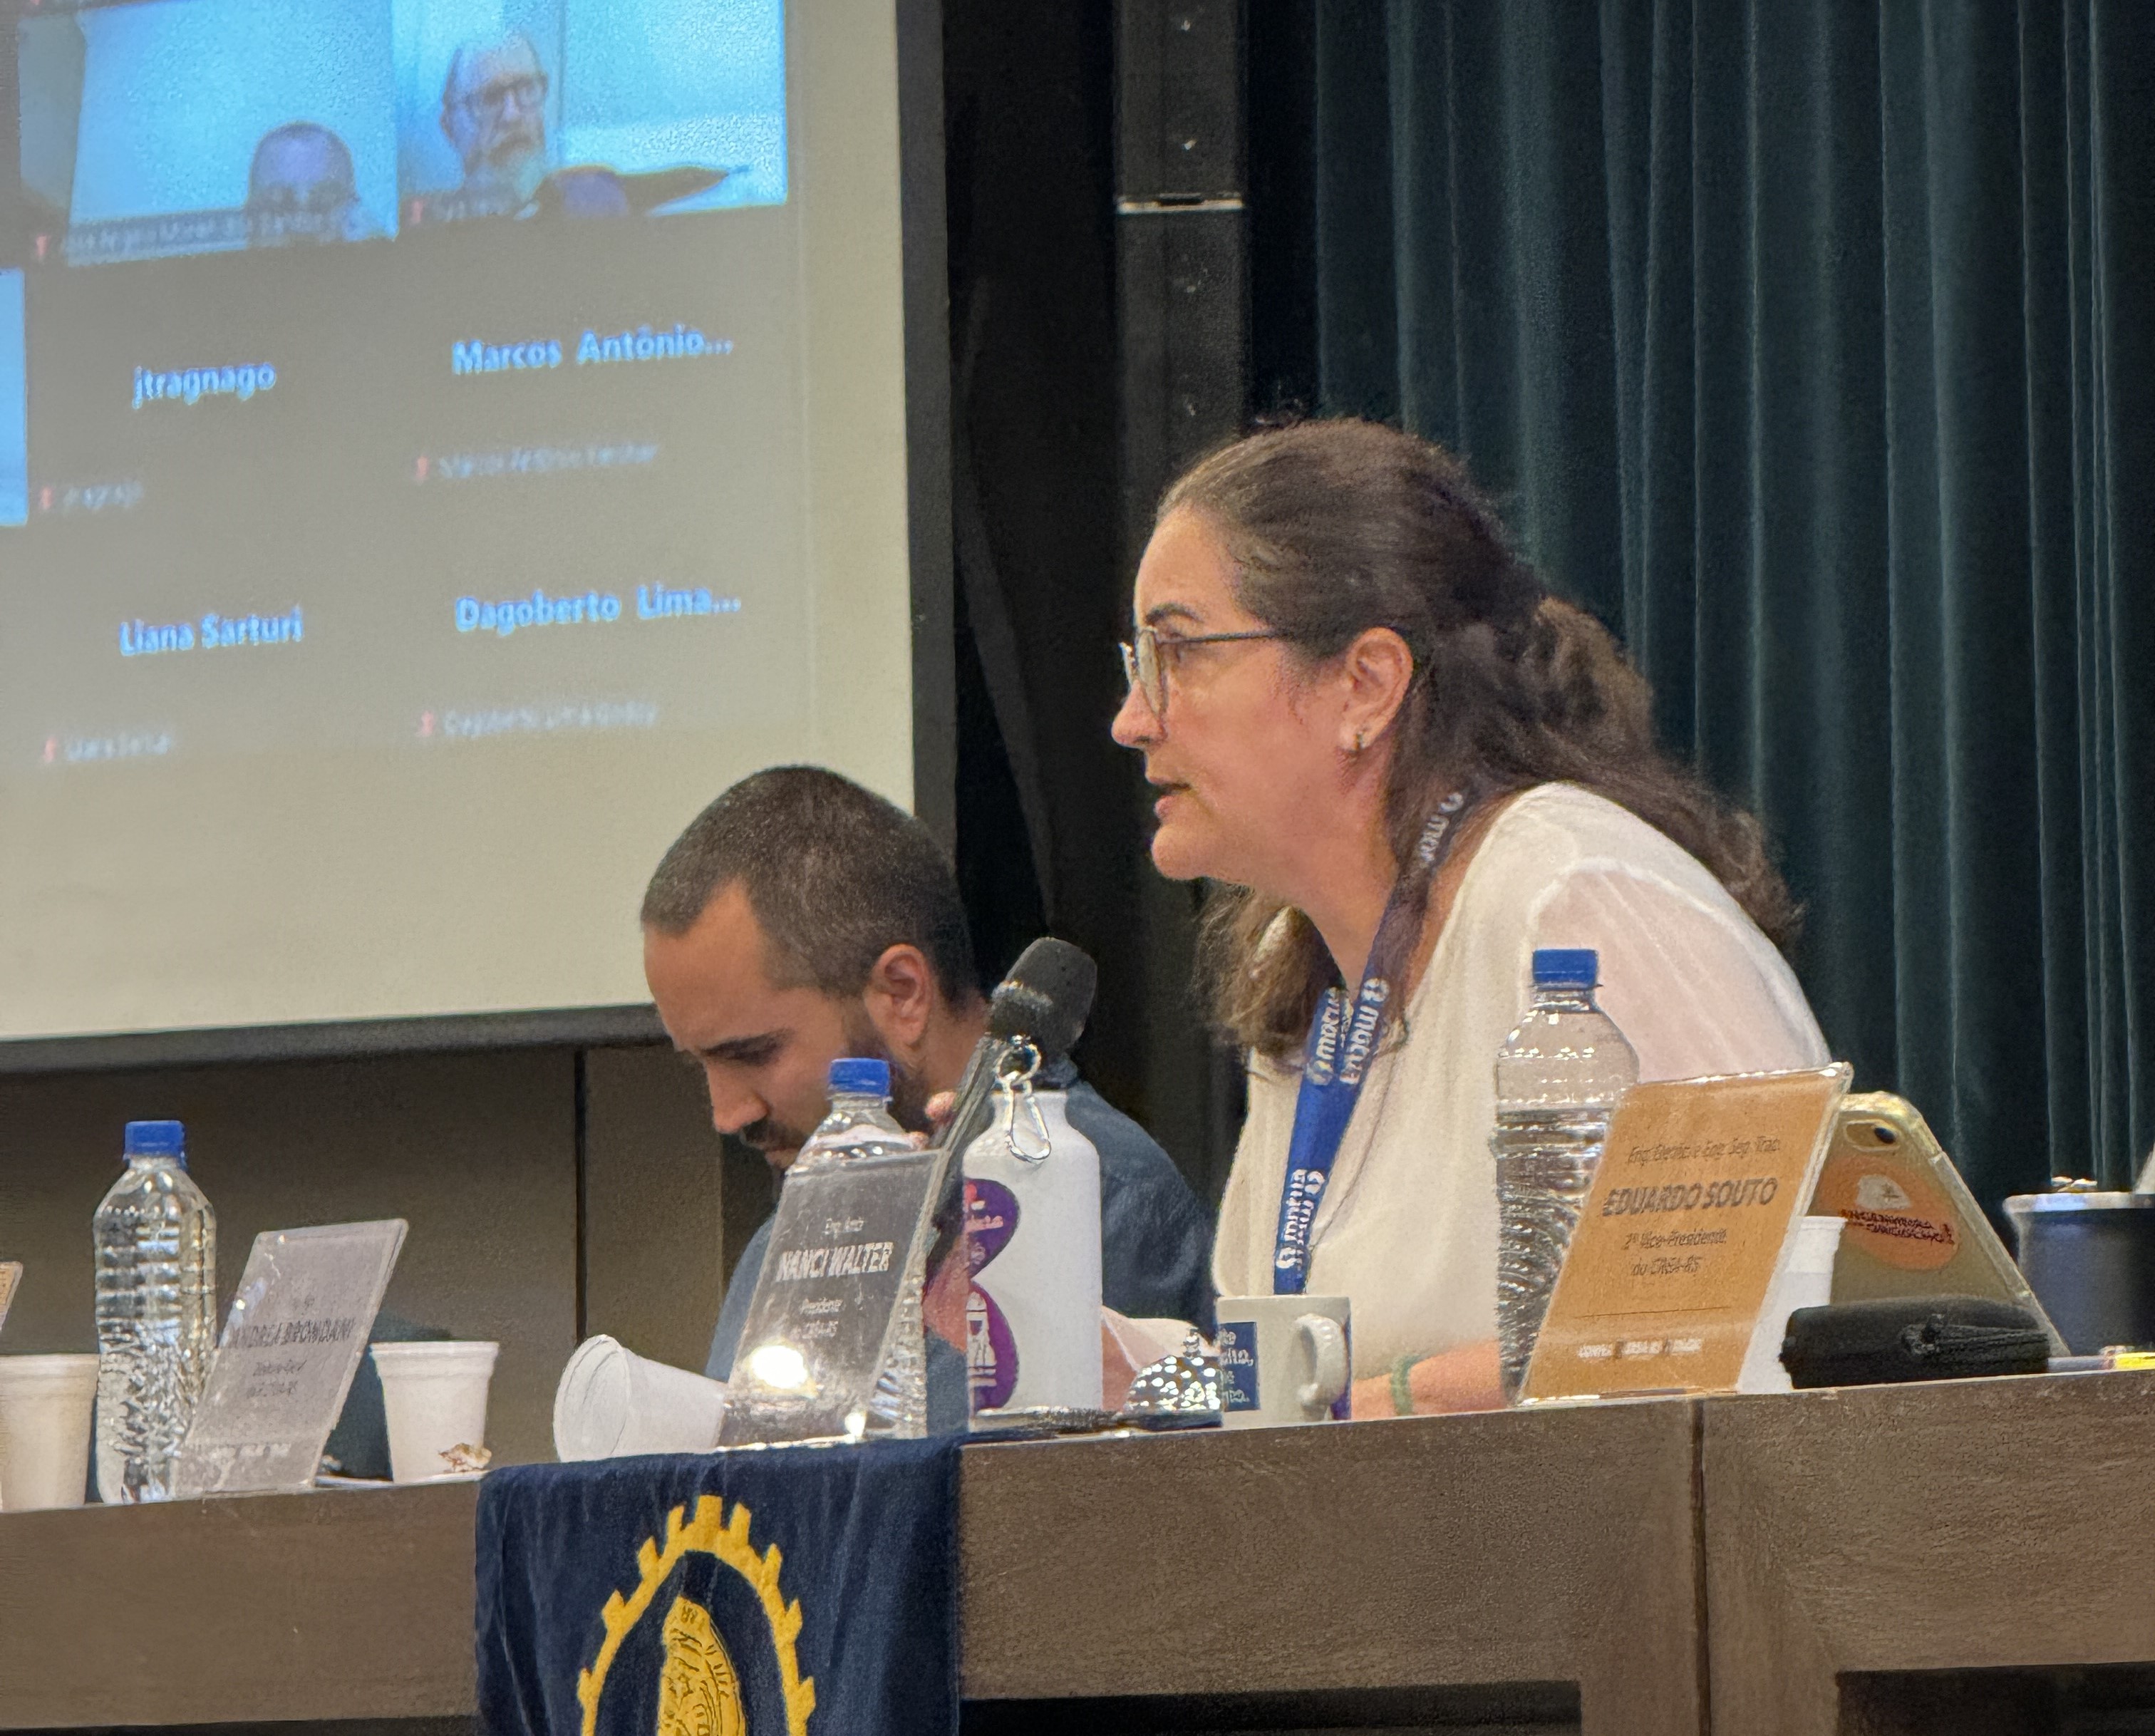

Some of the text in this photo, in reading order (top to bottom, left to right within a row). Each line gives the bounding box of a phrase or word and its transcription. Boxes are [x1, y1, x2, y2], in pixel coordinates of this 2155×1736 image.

[453, 338, 562, 376] Marcos
[456, 589, 621, 636] Dagoberto
[119, 619, 195, 656] Liana
[1601, 1177, 1778, 1216] EDUARDO SOUTO
[776, 1241, 894, 1282] NANCI WALTER
